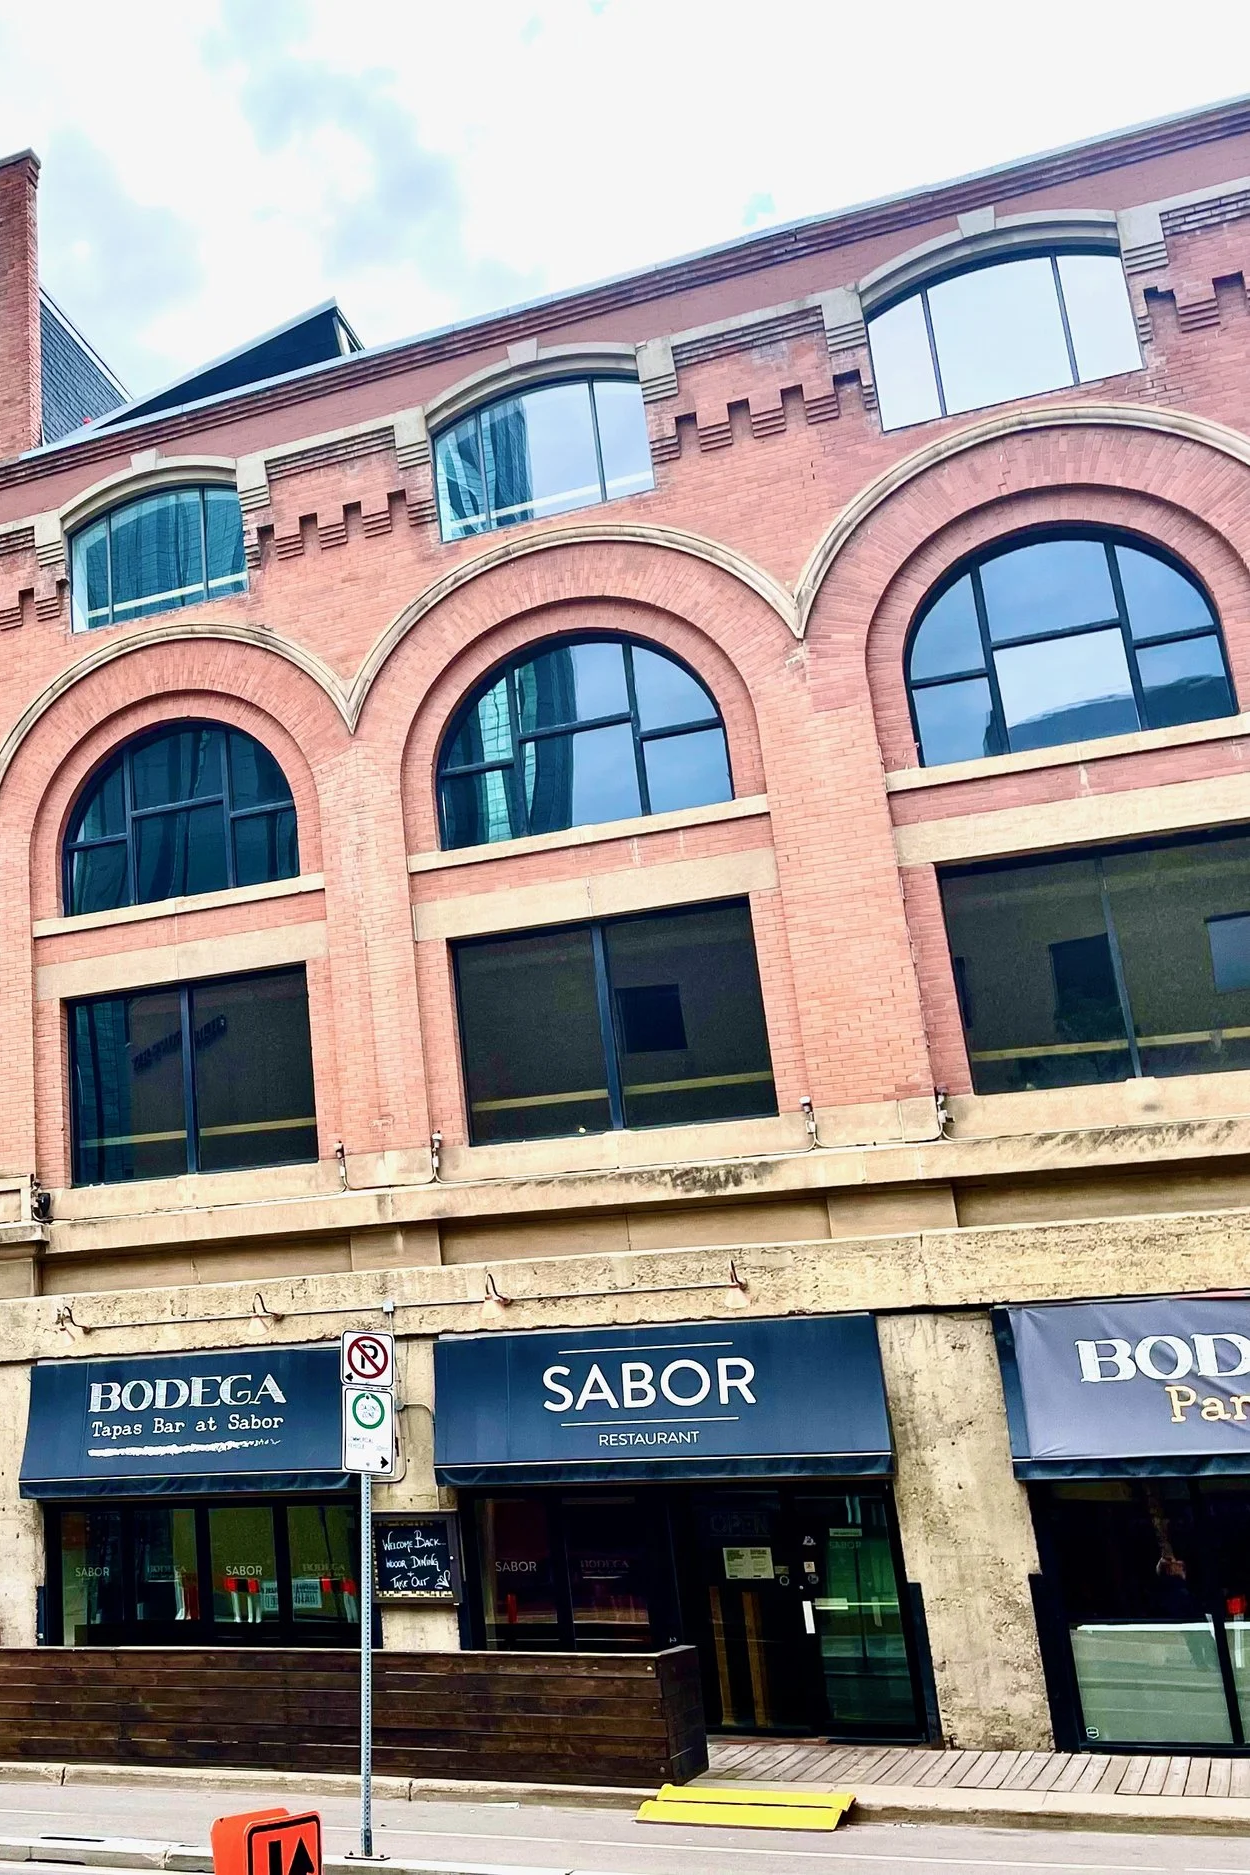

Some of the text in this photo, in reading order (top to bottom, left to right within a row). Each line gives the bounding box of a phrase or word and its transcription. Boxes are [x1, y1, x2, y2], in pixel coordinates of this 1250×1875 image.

[1074, 1333, 1250, 1383] BOD
[88, 1373, 287, 1413] BODEGA
[542, 1356, 757, 1412] SABOR
[1165, 1385, 1250, 1423] Par
[91, 1413, 284, 1440] Tapas Bar at Sabor
[598, 1430, 700, 1447] RESTAURANT
[75, 1567, 110, 1577] SABOR
[225, 1565, 263, 1576] SABOR
[495, 1561, 537, 1572] SABOR
